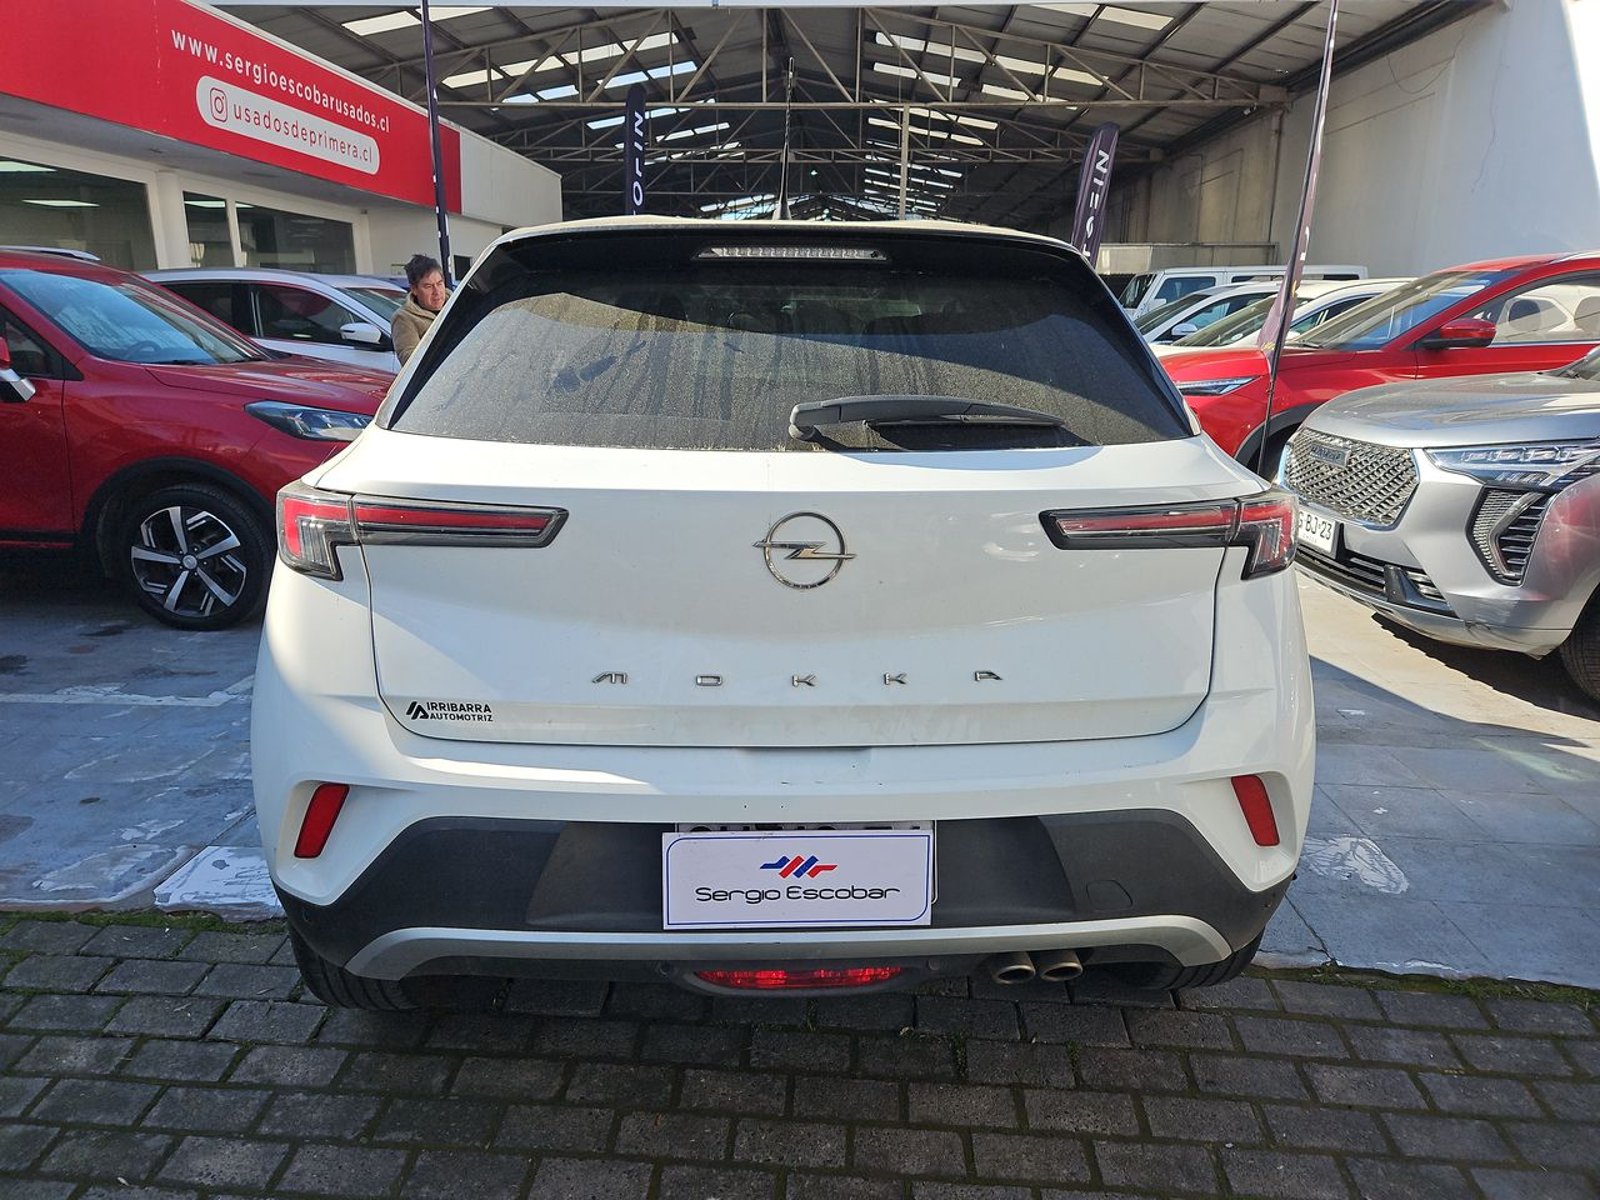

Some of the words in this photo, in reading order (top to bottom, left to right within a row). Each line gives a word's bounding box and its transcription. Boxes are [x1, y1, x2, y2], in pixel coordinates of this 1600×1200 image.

[171, 29, 391, 133] www.sergioescobarusados.cl
[234, 102, 373, 163] usadosdeprimera.cl
[426, 702, 492, 713] IRRIBARRA
[430, 713, 493, 722] AUTOMOTRIZ
[695, 886, 781, 904] Sergio
[786, 885, 900, 900] Escobar
